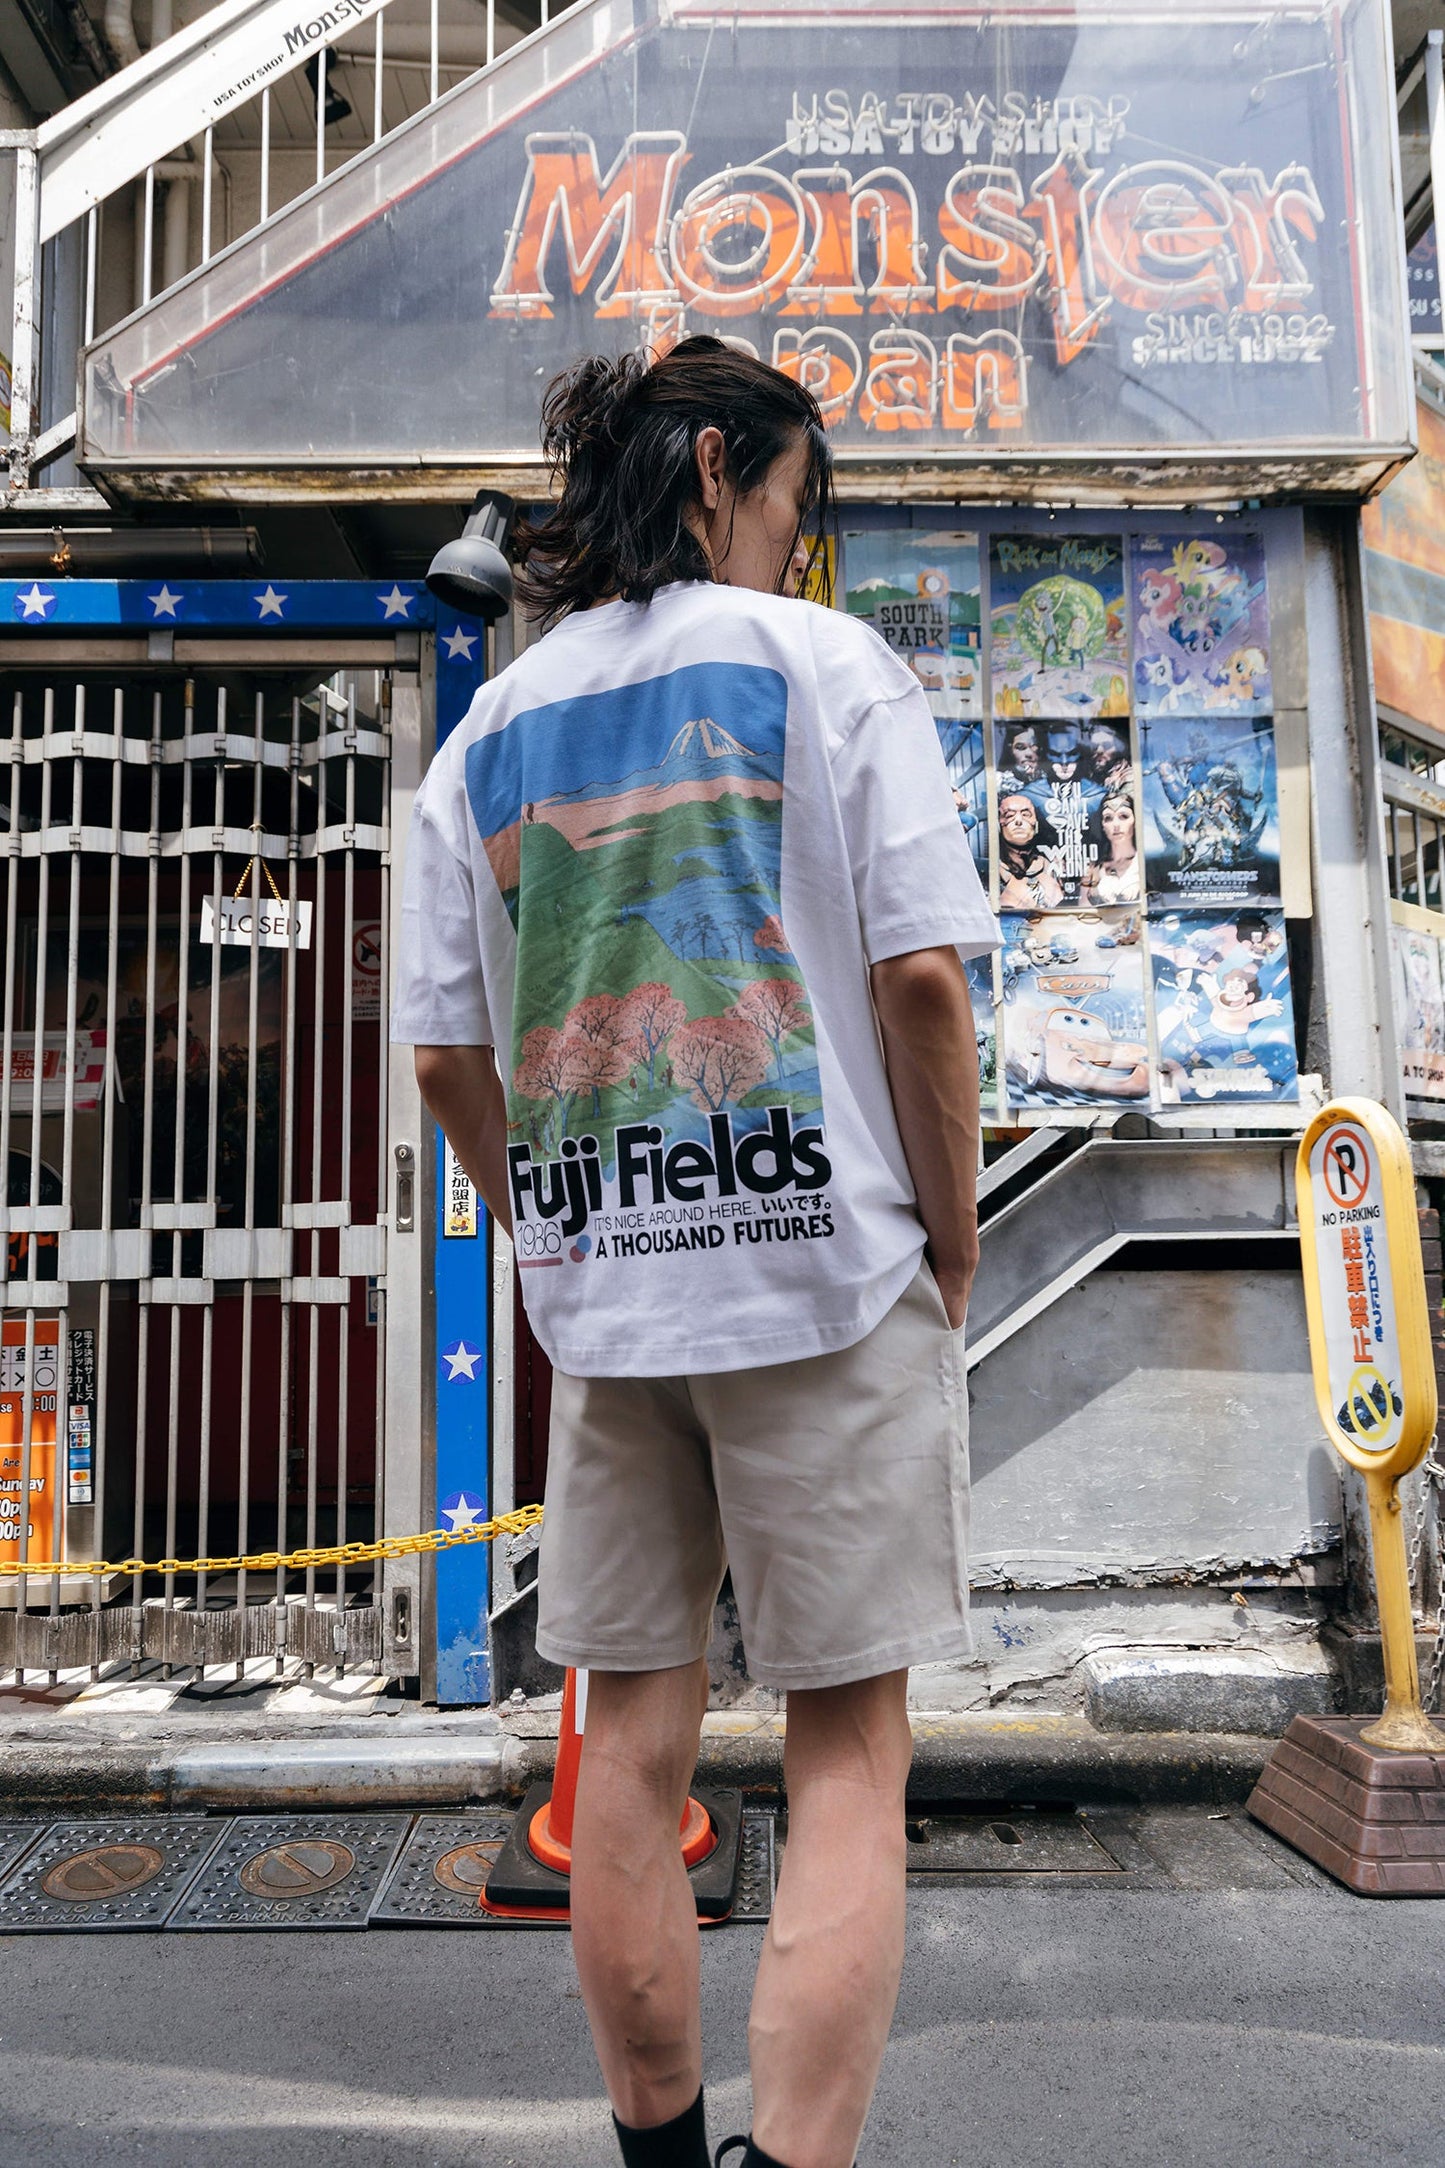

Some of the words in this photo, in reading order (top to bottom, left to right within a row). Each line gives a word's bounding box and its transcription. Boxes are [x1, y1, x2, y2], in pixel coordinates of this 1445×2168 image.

[213, 88, 237, 106] USA
[236, 73, 257, 91] TOY
[257, 54, 285, 77] SHOP
[785, 89, 888, 155] USA
[889, 91, 996, 155] TOY
[992, 90, 1131, 155] SHOP
[486, 130, 1326, 366] Monster
[1132, 312, 1243, 364] SINCE
[1240, 313, 1336, 364] 1992
[646, 302, 1029, 431] pan
[880, 602, 944, 625] SOUTH
[883, 626, 945, 649] PARK
[1167, 870, 1259, 882] TRANSFORMERS
[202, 913, 302, 935] CLOSED
[508, 1136, 603, 1239] Fuji
[616, 1106, 833, 1208] Fields
[760, 1192, 832, 1214] いいです。
[593, 1216, 613, 1232] IT'S
[614, 1213, 645, 1230] NICE
[648, 1206, 705, 1226] AROUND
[709, 1200, 757, 1220] HERE.
[1322, 1212, 1338, 1226] NO
[1339, 1204, 1381, 1224] PARKING
[517, 1221, 562, 1256] 1986
[595, 1236, 608, 1259] A
[611, 1224, 726, 1258] THOUSAND
[733, 1213, 835, 1246] FUTURES
[1340, 1225, 1375, 1364] 駐車禁止
[1362, 1224, 1385, 1344] 出入り口につき
[39, 1346, 54, 1361] 土
[73, 1330, 84, 1402] クレジットカード
[71, 1422, 90, 1430] VISA
[0, 1477, 45, 1492] unay
[55, 1904, 91, 1915] NO
[257, 1901, 291, 1912] NO
[431, 1907, 500, 1918] PARKI
[459, 1900, 479, 1909] N
[22, 1912, 108, 1924] PARKING
[227, 1911, 313, 1923] PARKING
